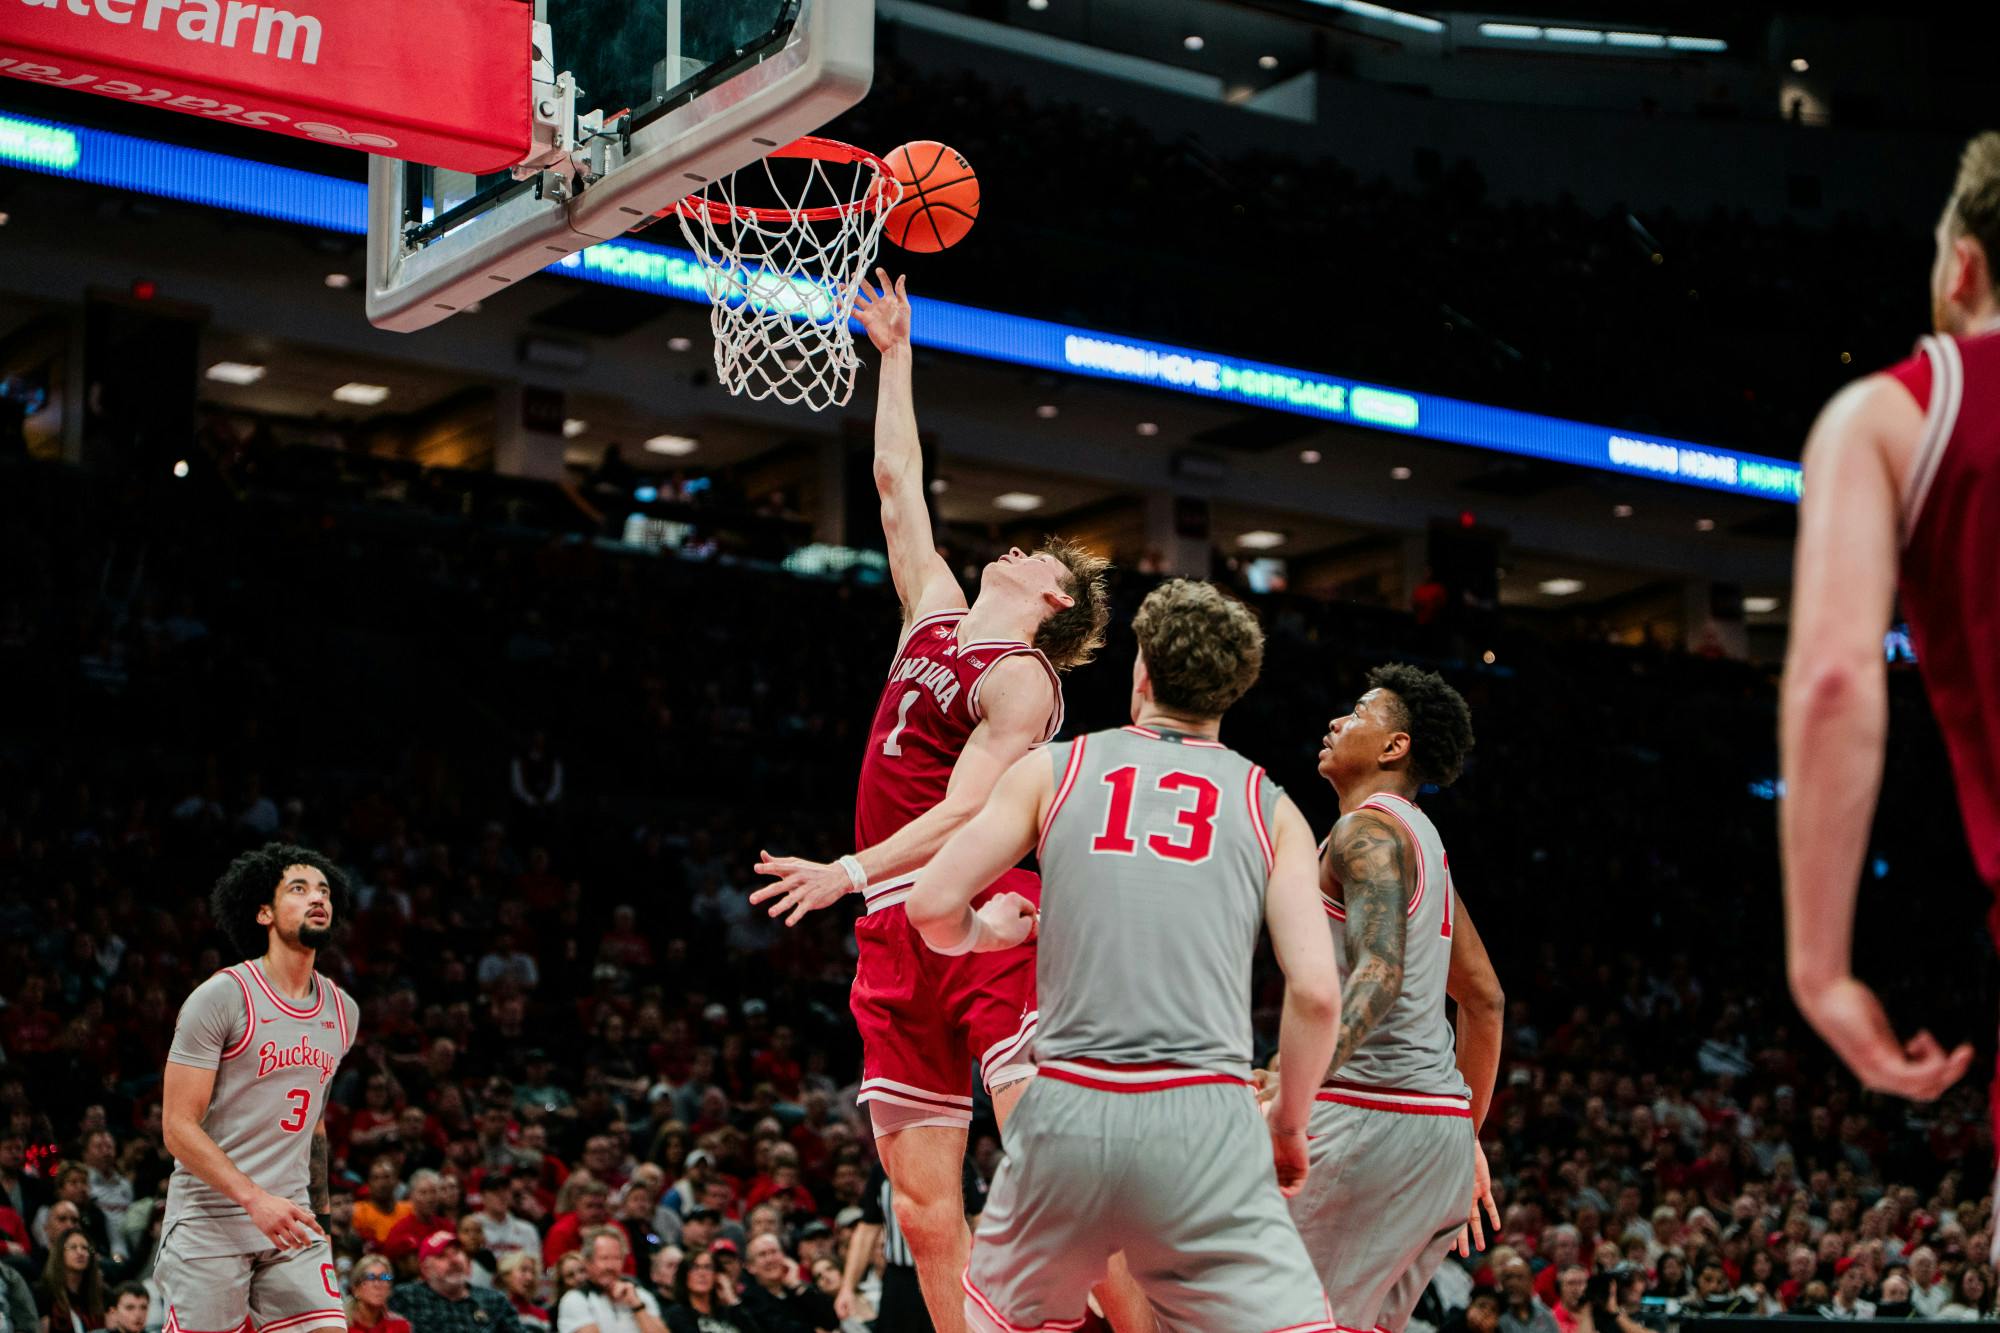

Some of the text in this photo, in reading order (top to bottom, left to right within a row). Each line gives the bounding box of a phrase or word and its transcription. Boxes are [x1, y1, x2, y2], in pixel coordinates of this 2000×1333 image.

[0, 57, 291, 126] State Fa
[882, 690, 921, 757] 1
[1089, 763, 1223, 866] 13
[279, 1088, 311, 1134] 3
